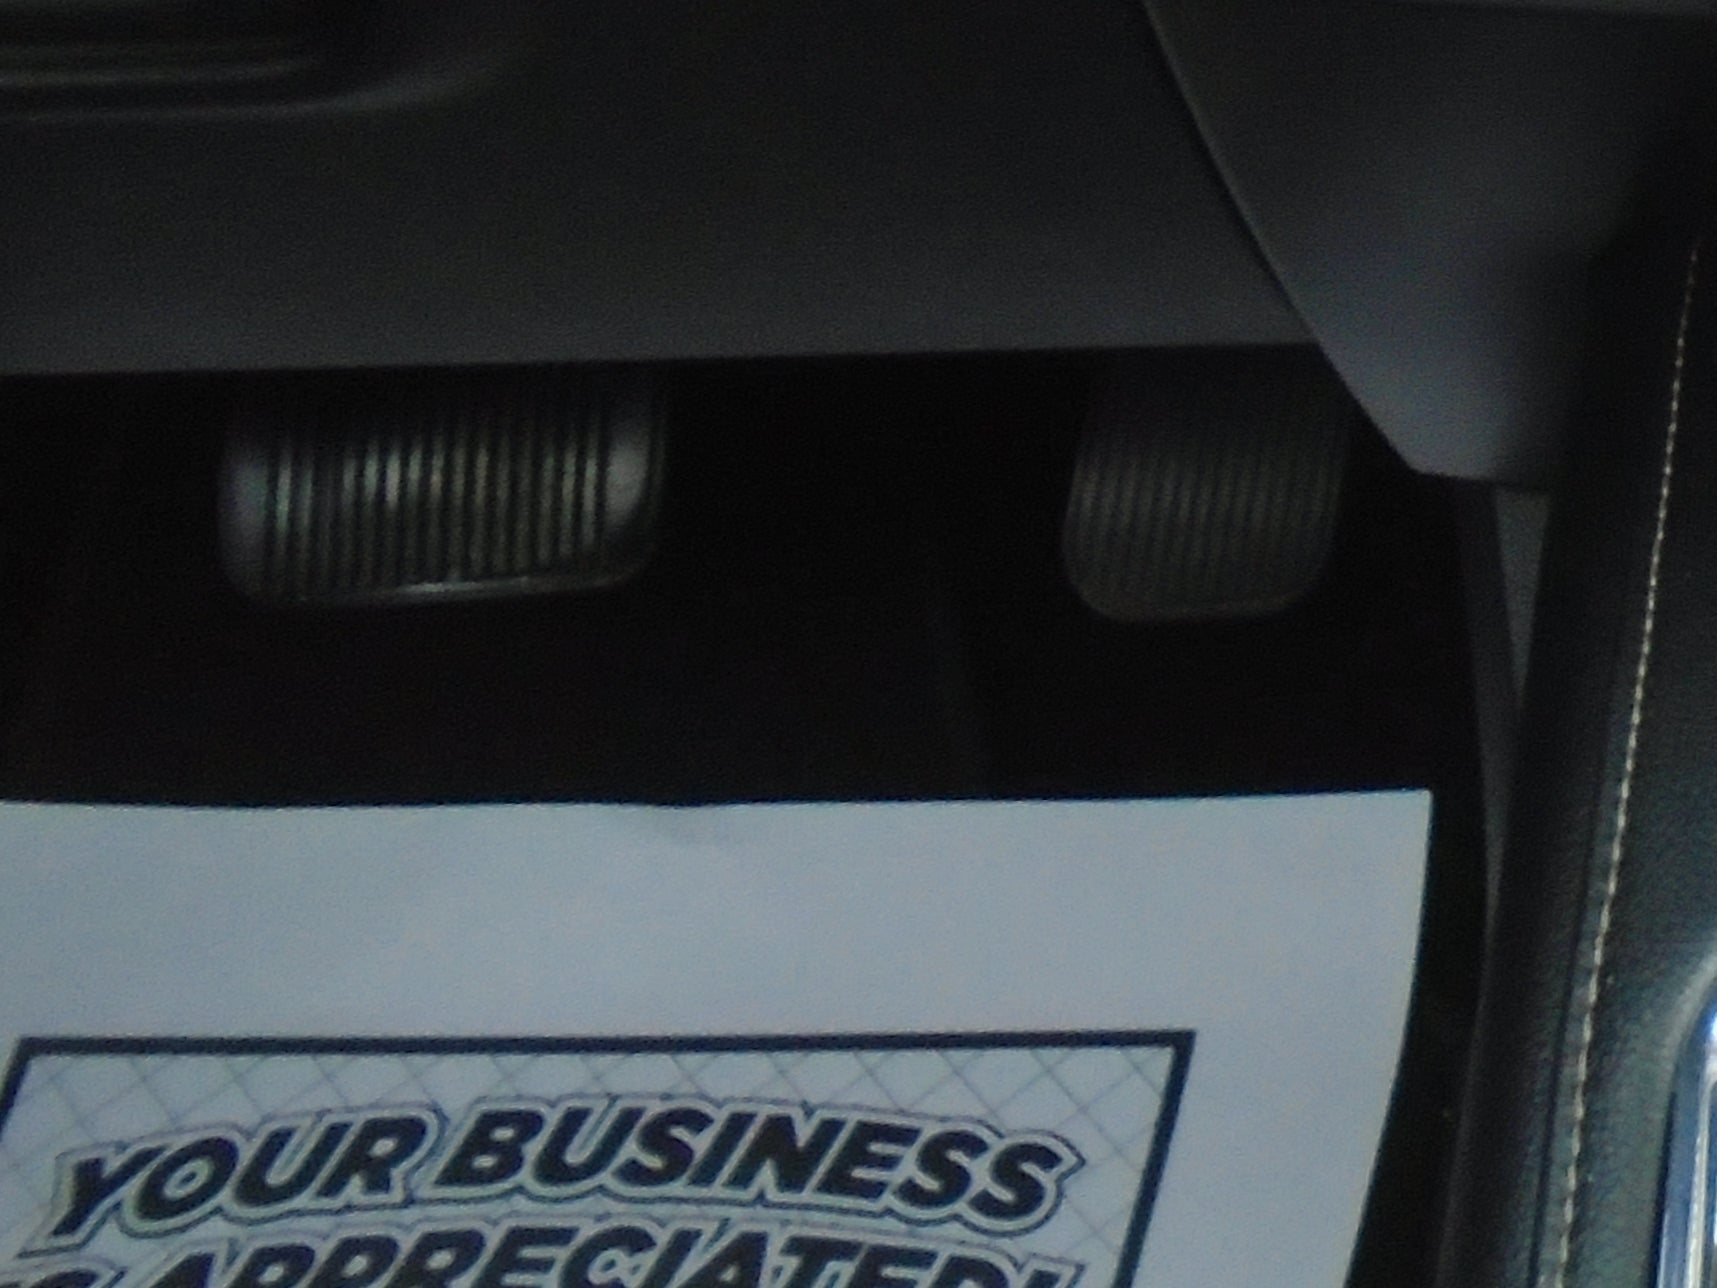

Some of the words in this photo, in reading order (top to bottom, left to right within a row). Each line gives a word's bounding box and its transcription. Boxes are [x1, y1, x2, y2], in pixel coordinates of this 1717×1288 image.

[52, 1116, 428, 1236] YOUR
[433, 1107, 1062, 1222] BUSINESS
[146, 1225, 1060, 1288] PPRECIATE
